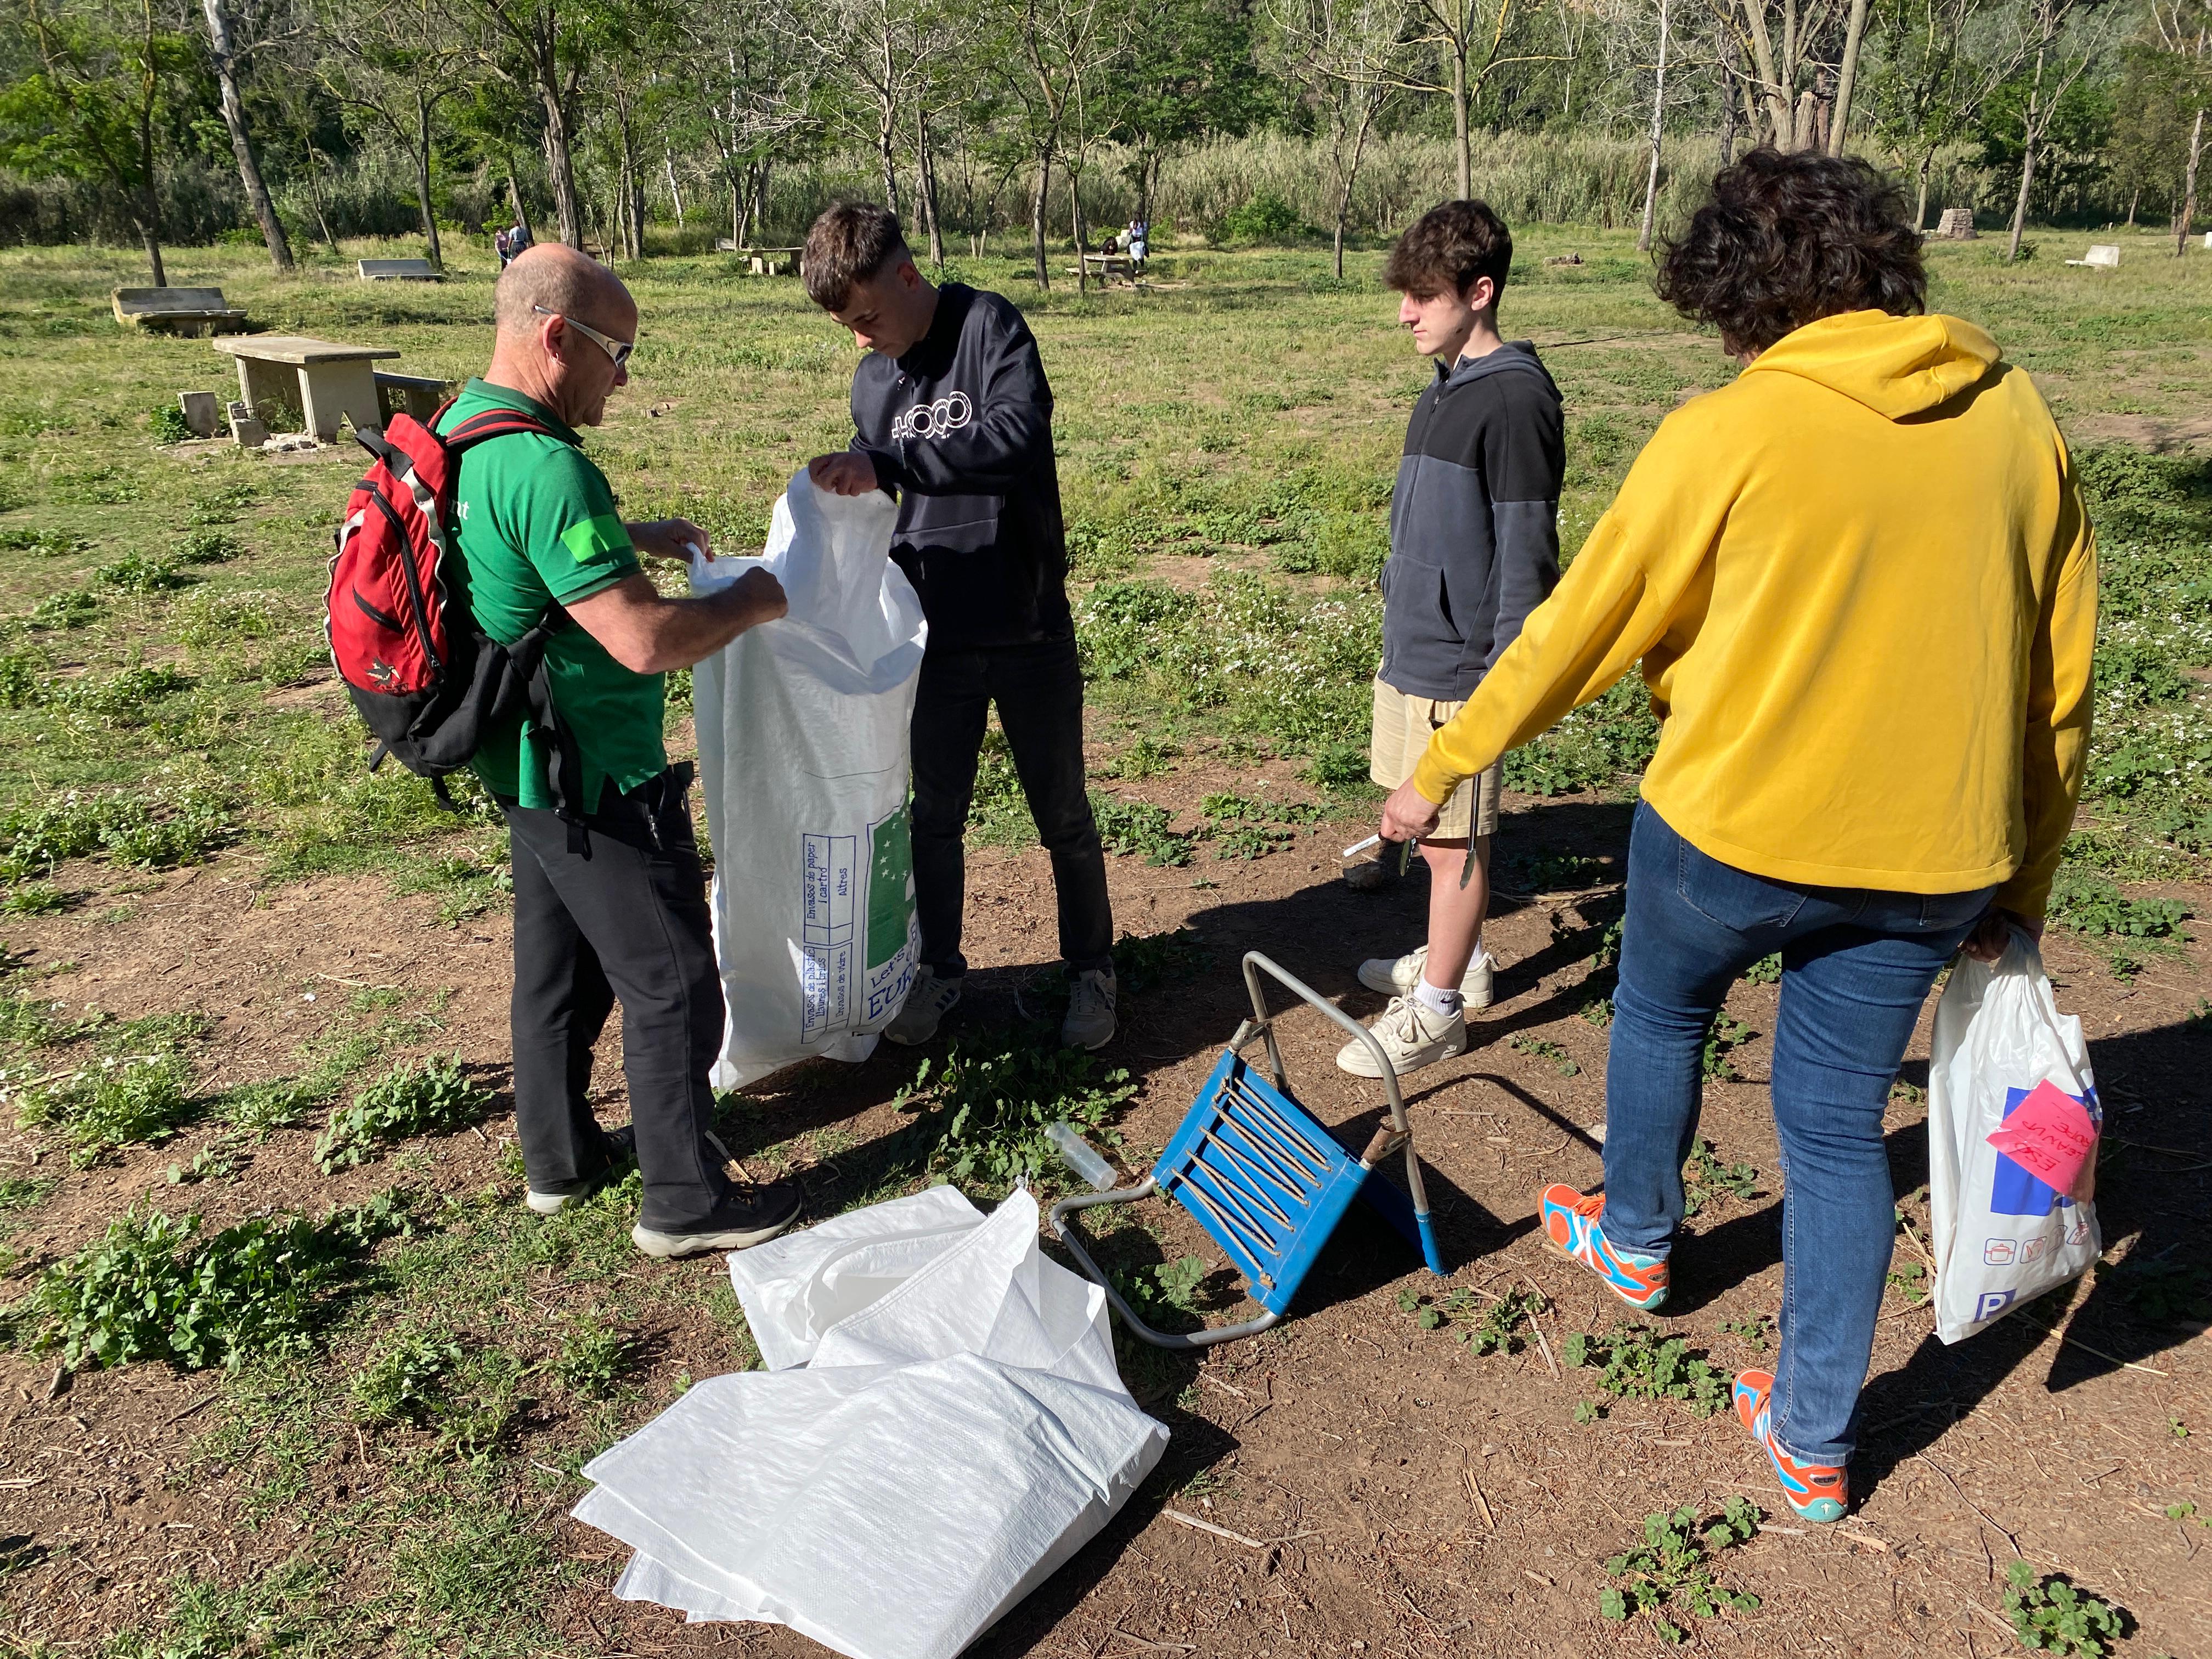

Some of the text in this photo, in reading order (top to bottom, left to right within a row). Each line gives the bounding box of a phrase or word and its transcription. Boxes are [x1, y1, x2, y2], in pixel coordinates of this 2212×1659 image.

[805, 842, 818, 919] Envasos de paper
[817, 867, 828, 898] cartró
[837, 868, 848, 896] Altres
[816, 957, 826, 980] brics
[836, 951, 846, 1018] Envasos de vidre
[805, 983, 815, 992] de
[868, 962, 912, 1020] EUR
[805, 994, 815, 1028] Envasos
